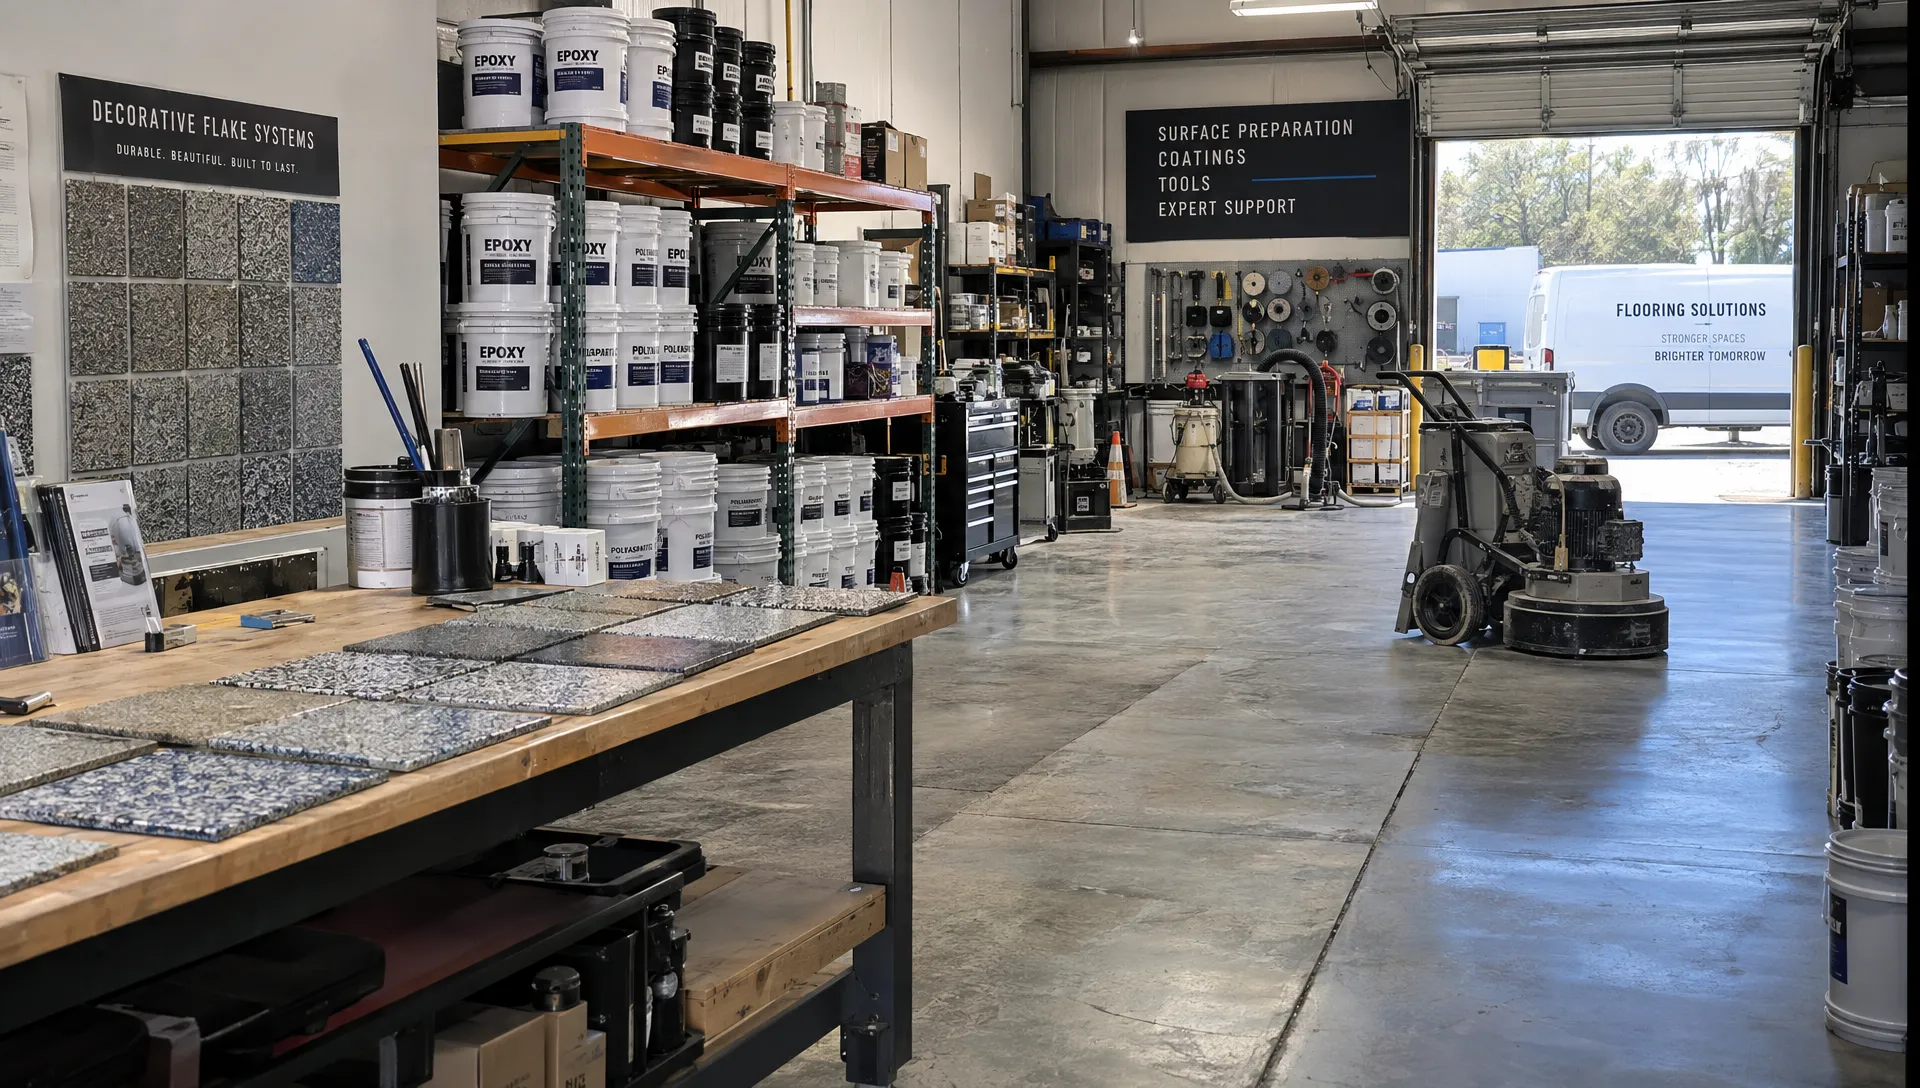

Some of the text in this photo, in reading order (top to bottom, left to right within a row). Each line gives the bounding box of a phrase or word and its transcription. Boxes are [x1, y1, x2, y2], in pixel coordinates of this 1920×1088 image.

[474, 55, 517, 67] EPOXY
[557, 49, 599, 62] EPOXY
[92, 99, 314, 150] DECORATIVE FLAKE SYSTEMS
[1158, 119, 1354, 141] SURFACE PREPARATION
[116, 143, 299, 174] DURABLE. BEAUTIFUL. BUILT TO LAST.
[1158, 148, 1247, 167] COATINGS
[1158, 175, 1211, 193] TOOLS
[1159, 198, 1296, 217] EXPERT SUPPORT
[484, 238, 532, 252] EPOXY
[1616, 303, 1766, 317] FLOORING SOLUTIONS
[1661, 333, 1746, 343] STRONGER SPACES
[480, 346, 526, 359] EPOXY
[1654, 350, 1766, 361] BRIGHTER TOMORROW
